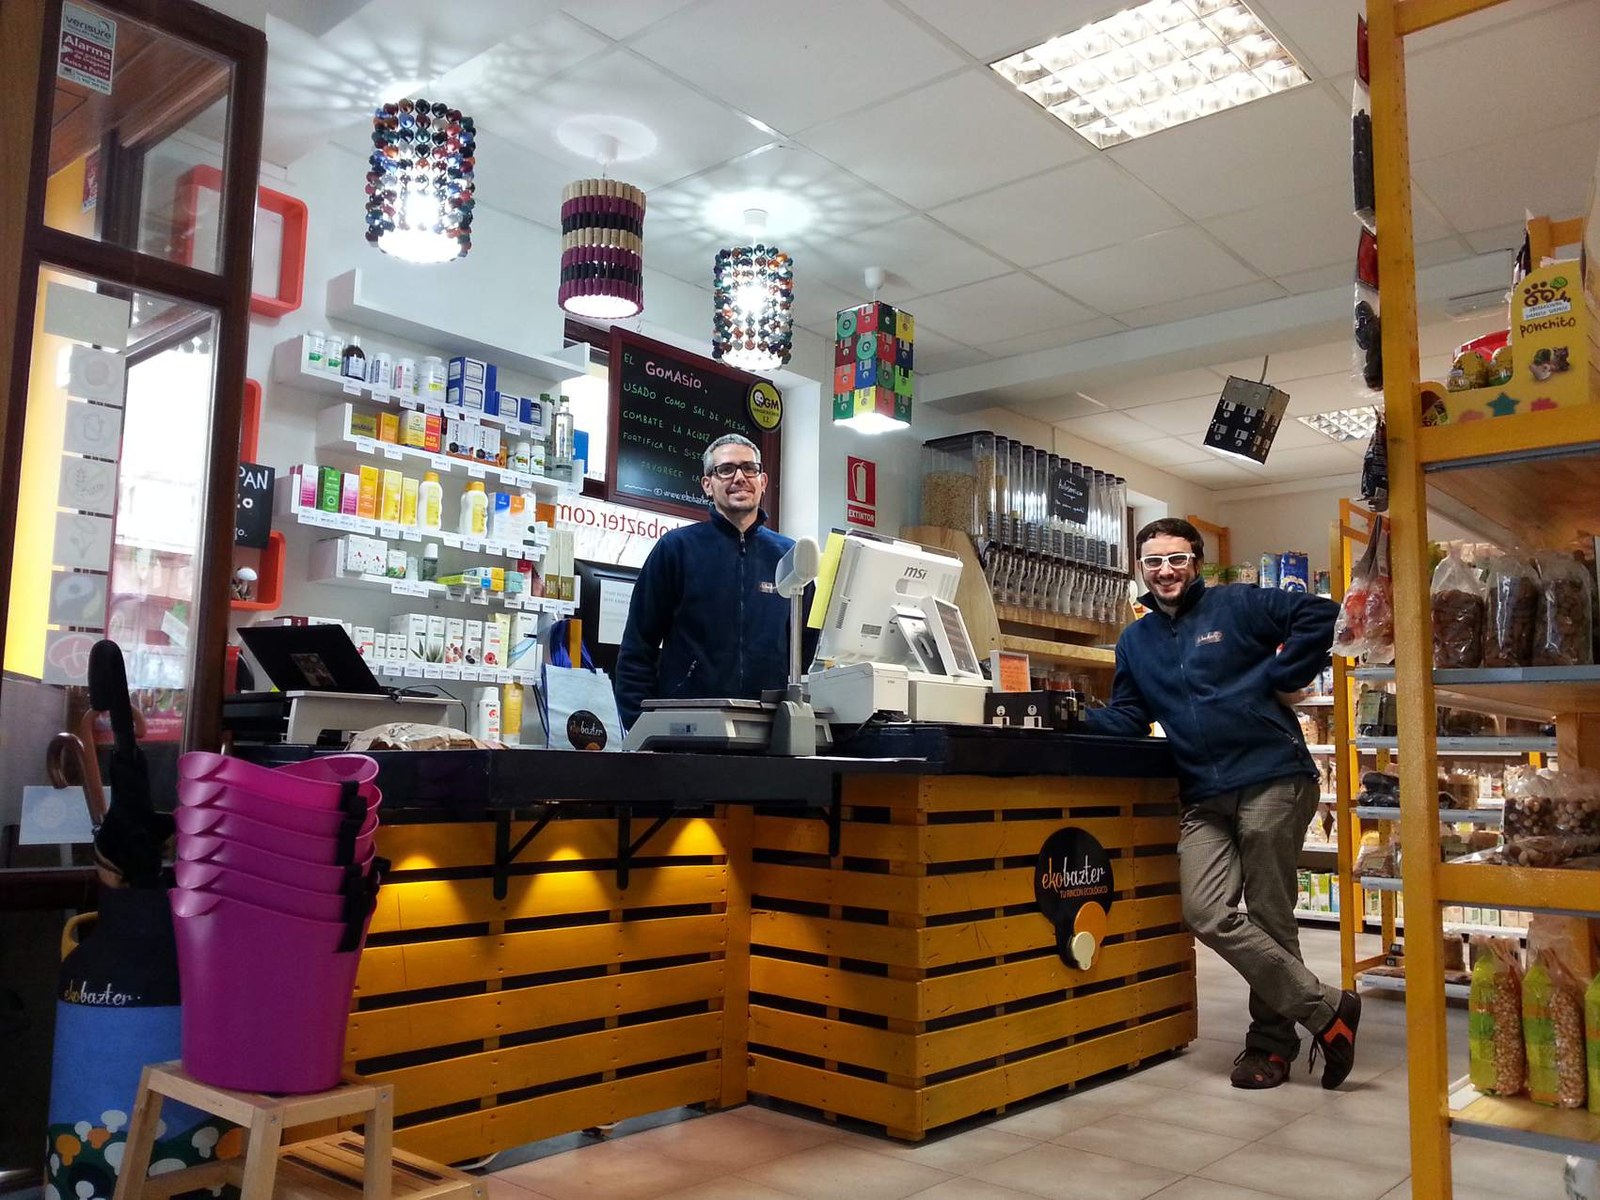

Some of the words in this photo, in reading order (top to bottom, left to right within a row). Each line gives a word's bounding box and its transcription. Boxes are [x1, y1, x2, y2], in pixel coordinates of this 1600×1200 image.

[64, 35, 111, 60] Alarma
[1519, 316, 1576, 339] ponchito
[623, 352, 634, 365] EL
[623, 383, 657, 400] USADO
[664, 396, 686, 410] COMO
[693, 405, 706, 417] SAL
[709, 411, 719, 421] DE
[622, 410, 664, 429] COMBATE
[672, 424, 682, 434] LA
[623, 431, 664, 449] FORTIFICA
[668, 445, 678, 454] EL
[903, 566, 928, 580] msi
[1041, 855, 1106, 894] ekobazter
[1060, 889, 1067, 899] TU
